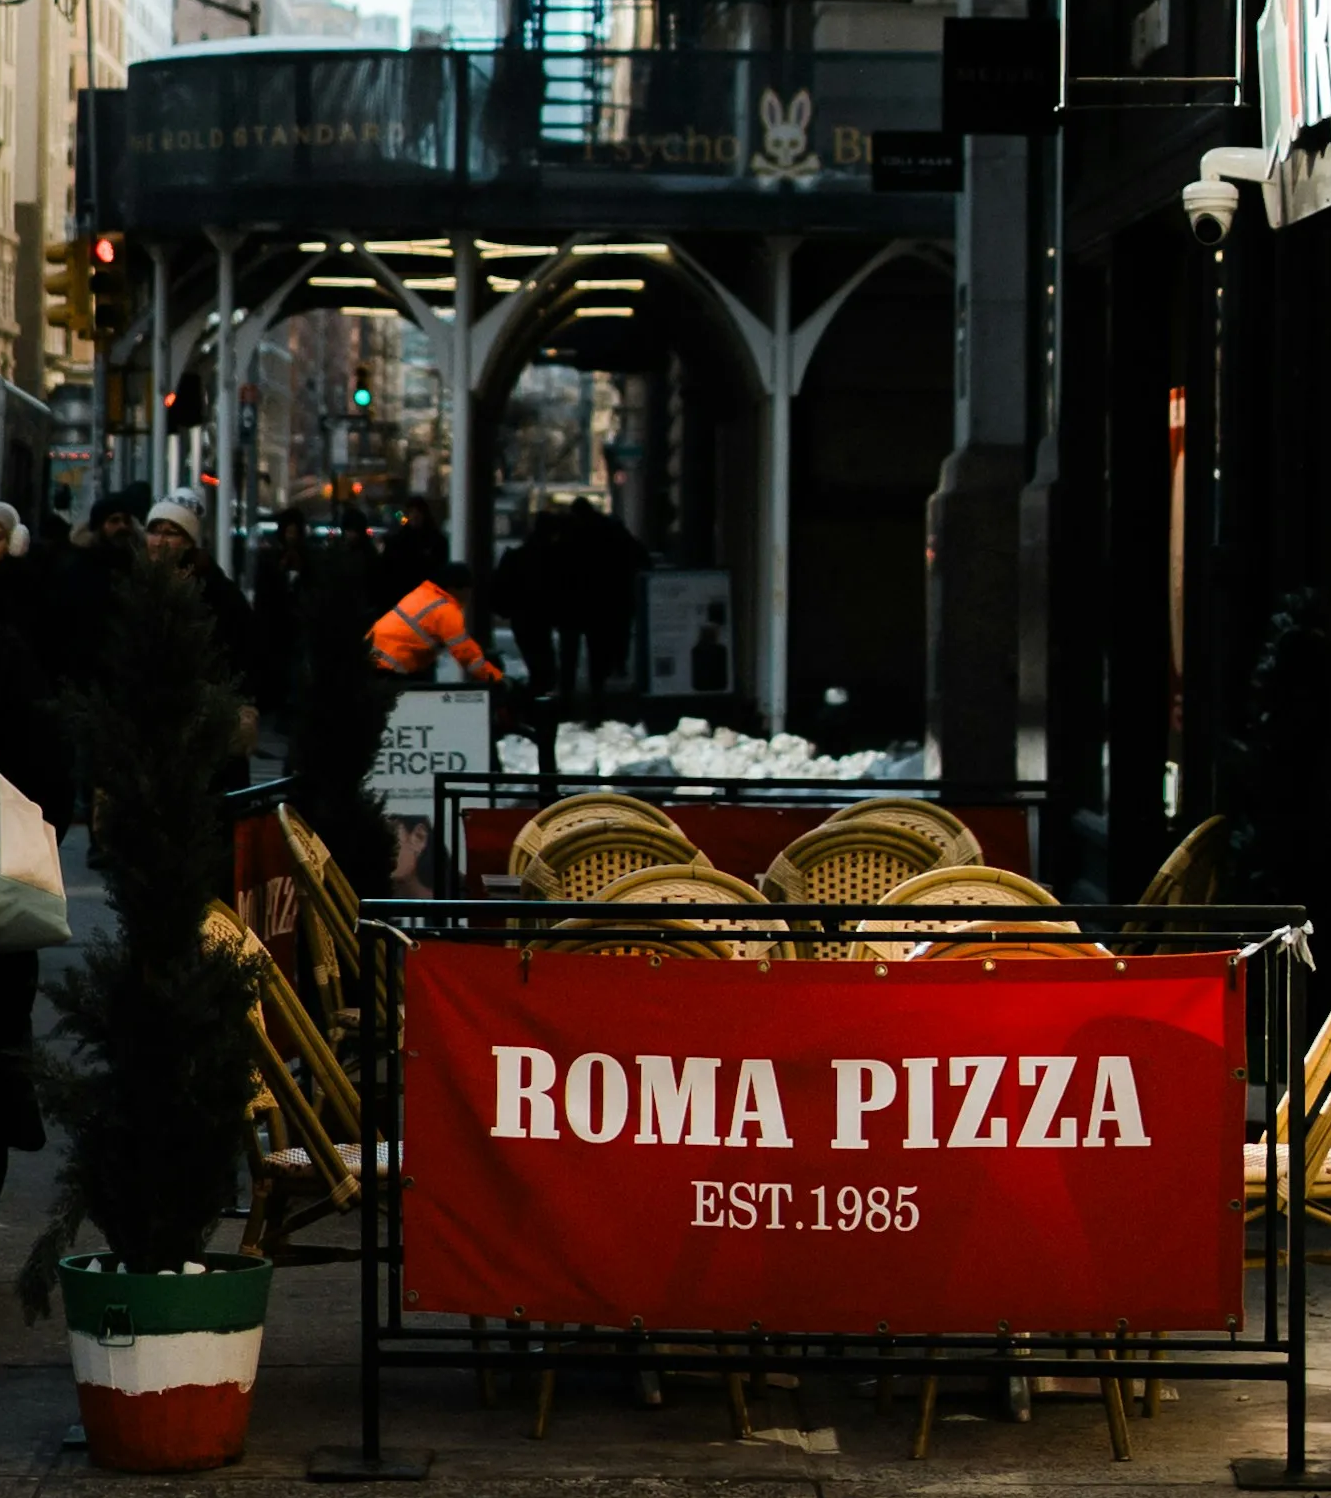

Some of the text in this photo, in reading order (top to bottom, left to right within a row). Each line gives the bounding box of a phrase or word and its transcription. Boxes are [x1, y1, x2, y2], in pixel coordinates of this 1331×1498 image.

[371, 751, 467, 776] ERCED
[489, 1045, 1152, 1151] ROMA PIZZA
[690, 1179, 921, 1234] EST.1985
